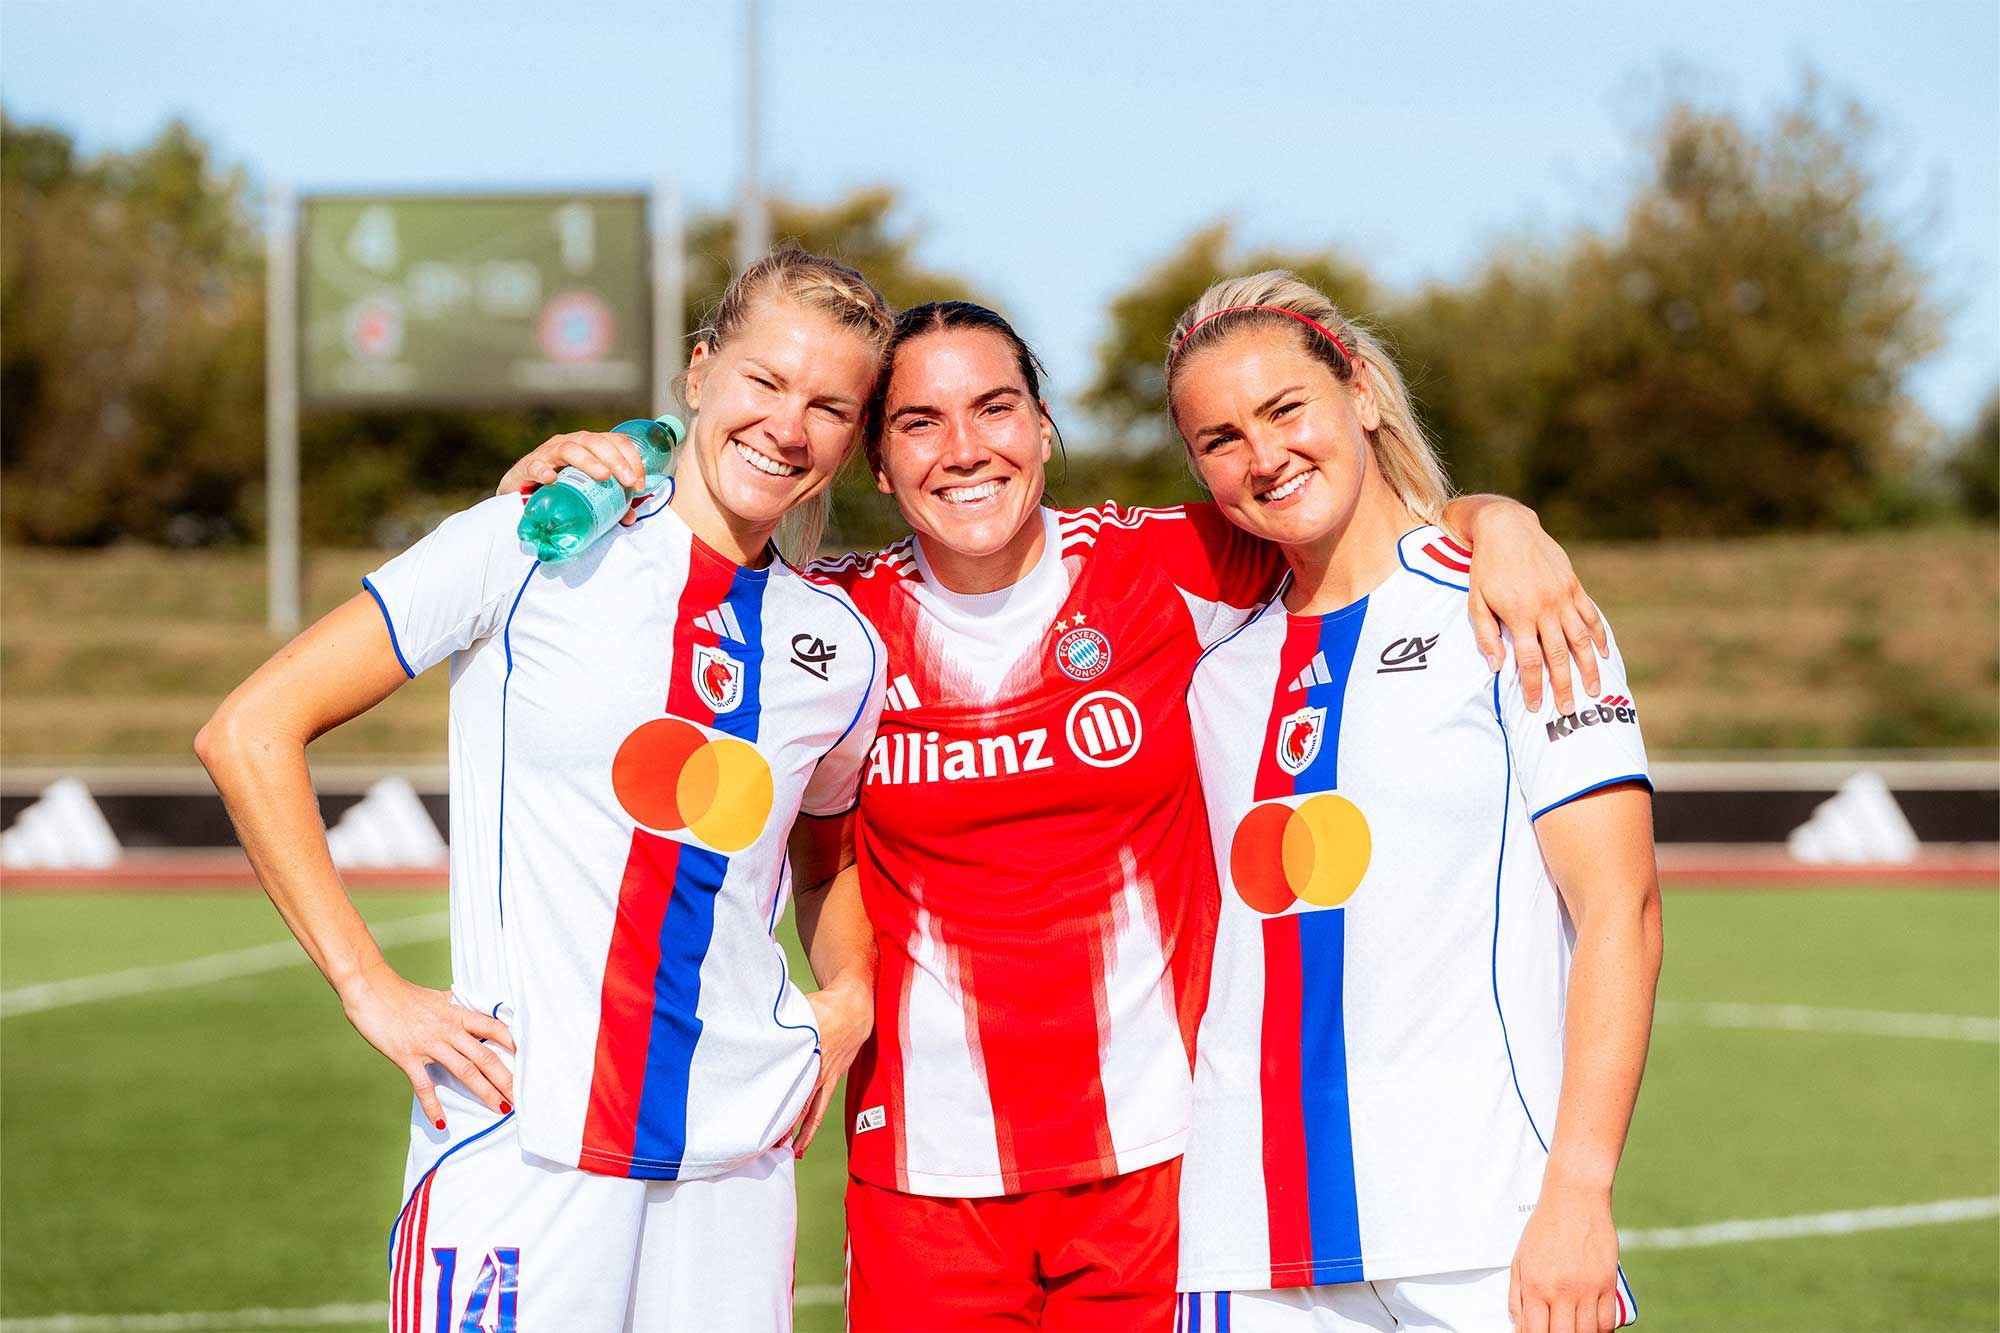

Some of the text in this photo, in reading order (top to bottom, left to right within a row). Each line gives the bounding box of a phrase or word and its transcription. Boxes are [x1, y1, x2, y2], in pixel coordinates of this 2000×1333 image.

[1060, 631, 1103, 657] FC BAYERN
[866, 727, 1055, 786] Allianz
[431, 1247, 520, 1333] 14
